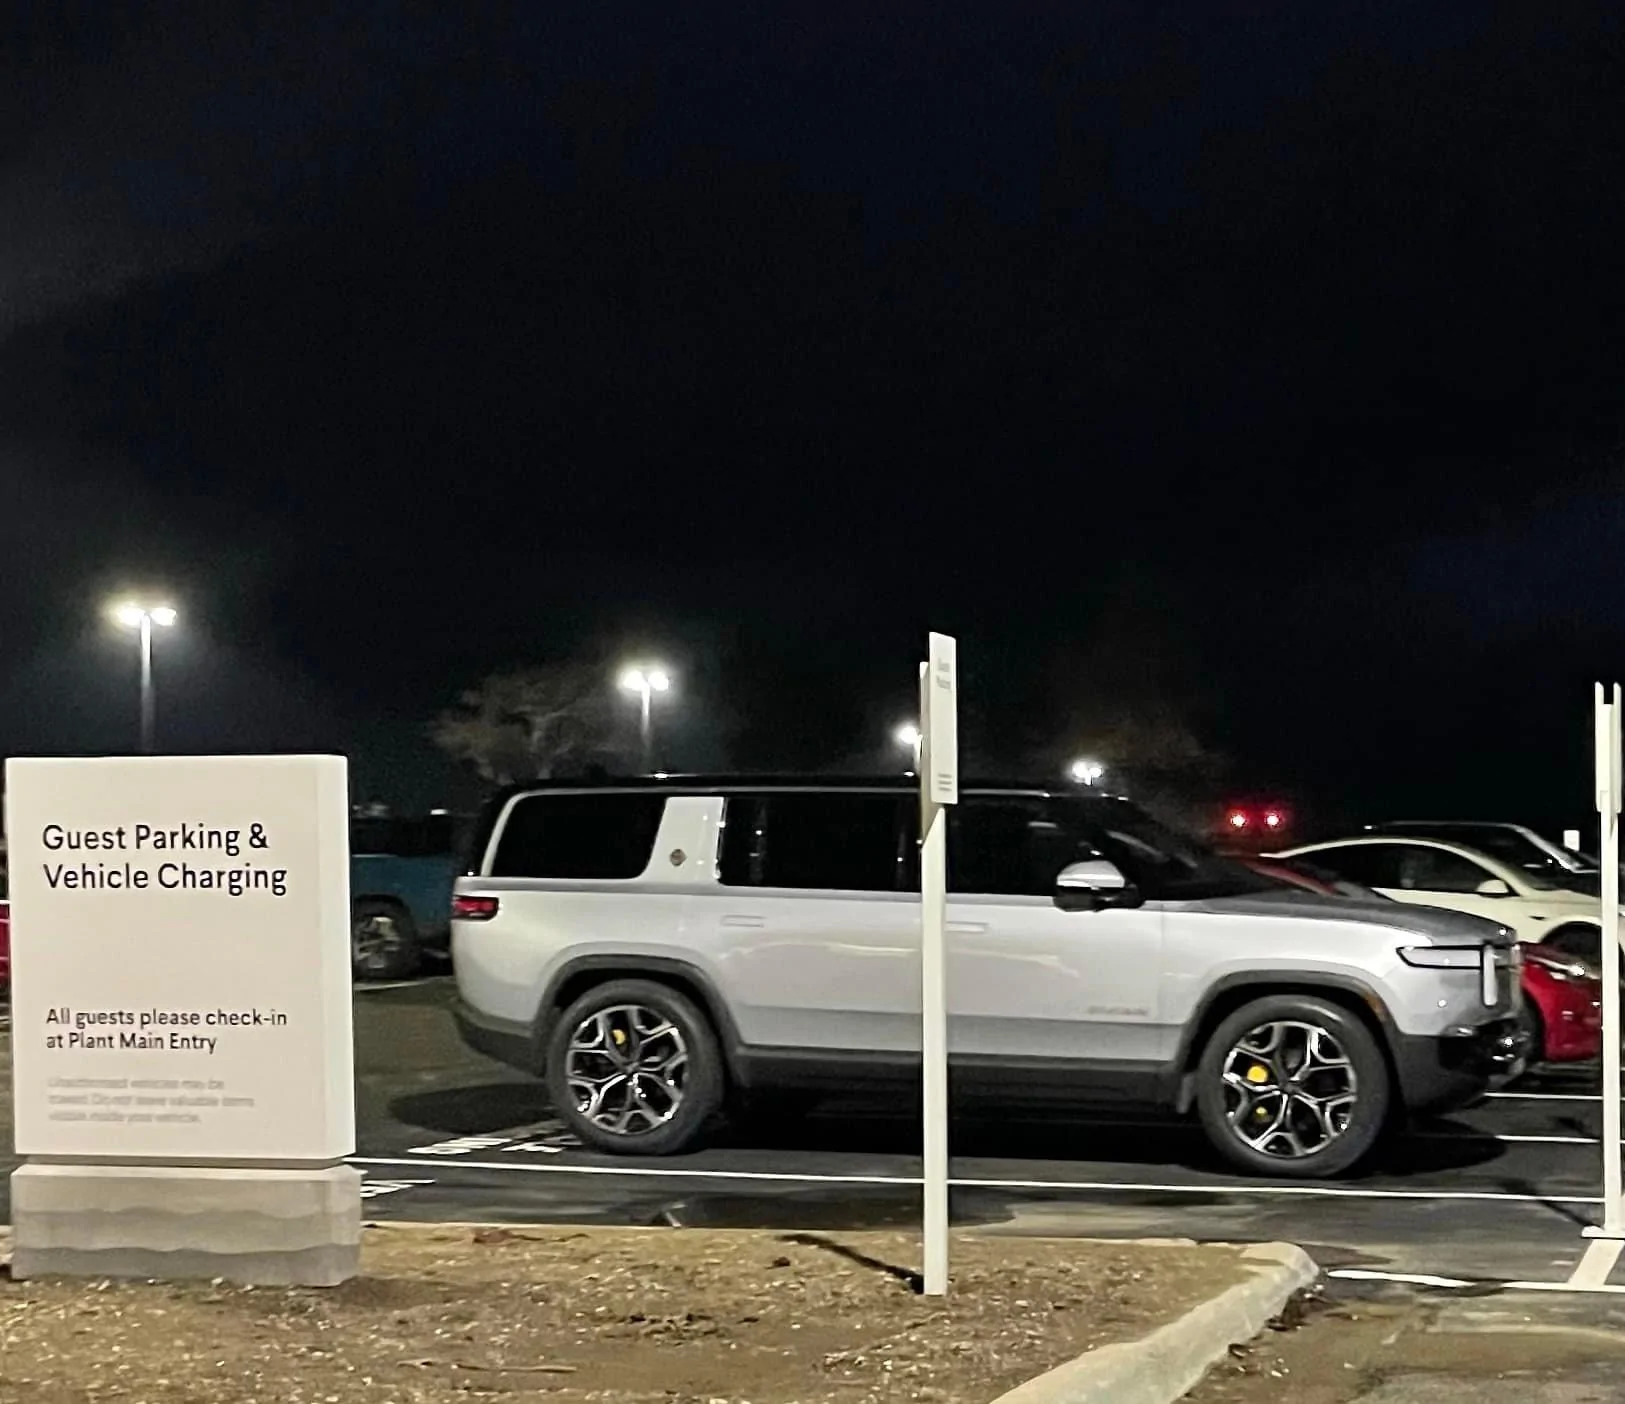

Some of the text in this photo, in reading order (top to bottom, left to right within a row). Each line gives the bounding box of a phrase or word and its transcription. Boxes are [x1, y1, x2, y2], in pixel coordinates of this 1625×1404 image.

[42, 821, 269, 857] Guest Parking &
[42, 861, 288, 897] Vehicle Charging
[45, 1006, 287, 1030] All guests please check-in
[45, 1030, 217, 1055] at Plant Main Entry
